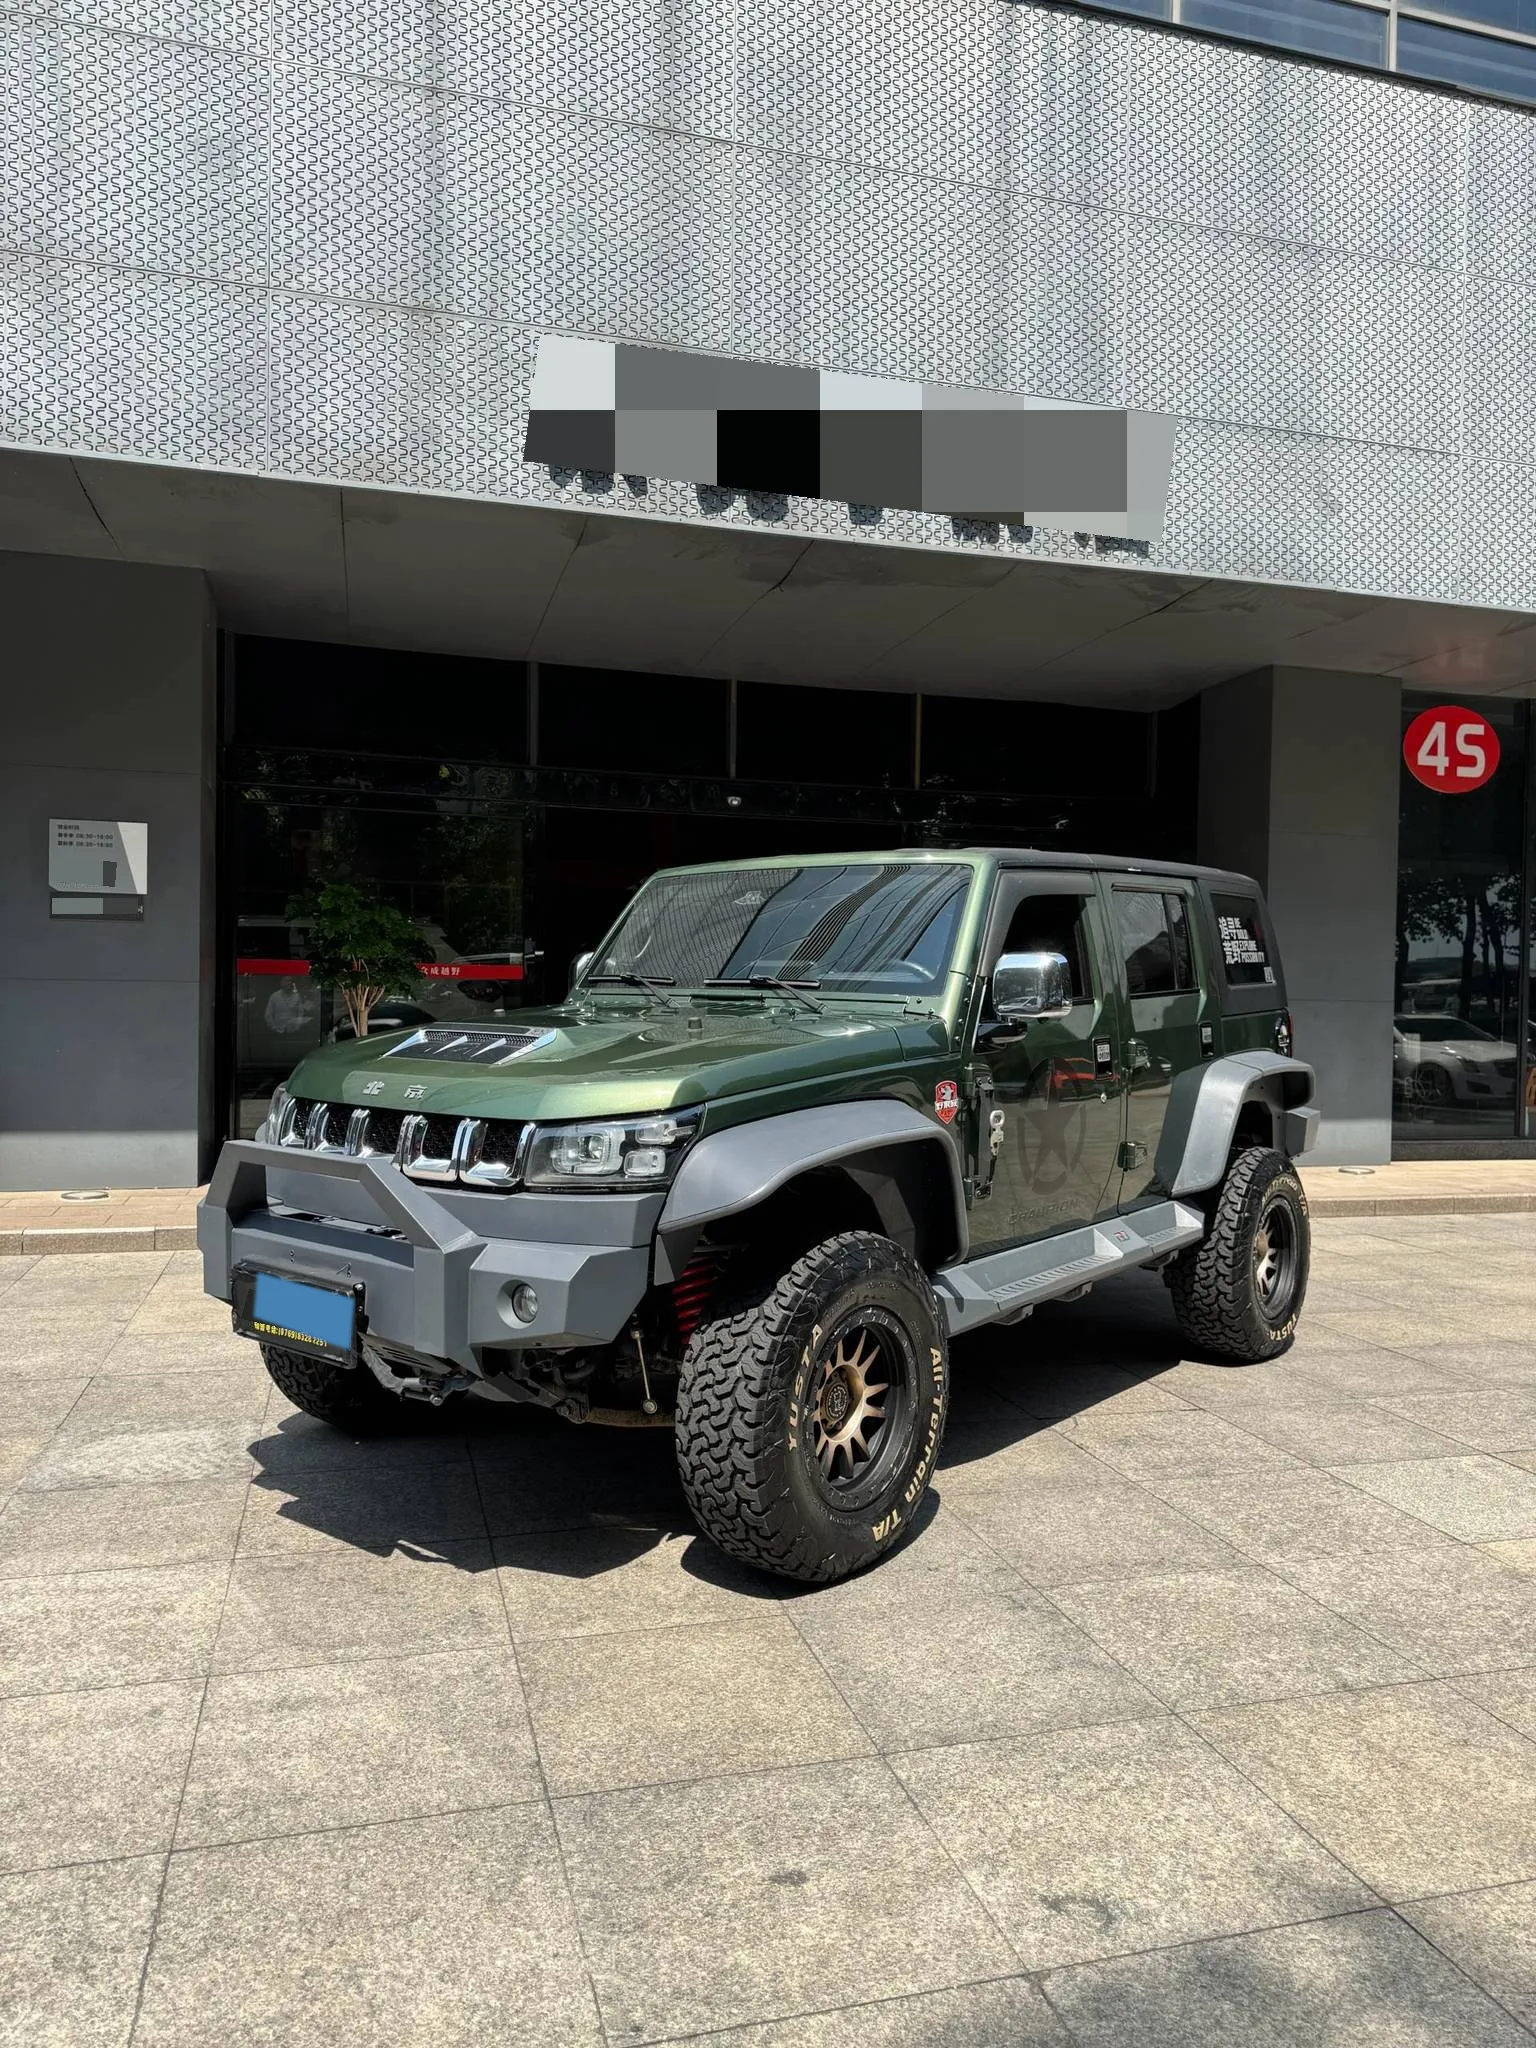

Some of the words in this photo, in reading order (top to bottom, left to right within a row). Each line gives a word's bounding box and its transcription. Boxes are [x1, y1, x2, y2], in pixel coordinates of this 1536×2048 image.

[1416, 721, 1487, 779] 4S
[362, 1081, 429, 1101] 北京
[904, 1346, 945, 1503] All-Terrain
[871, 1508, 903, 1543] T/A
